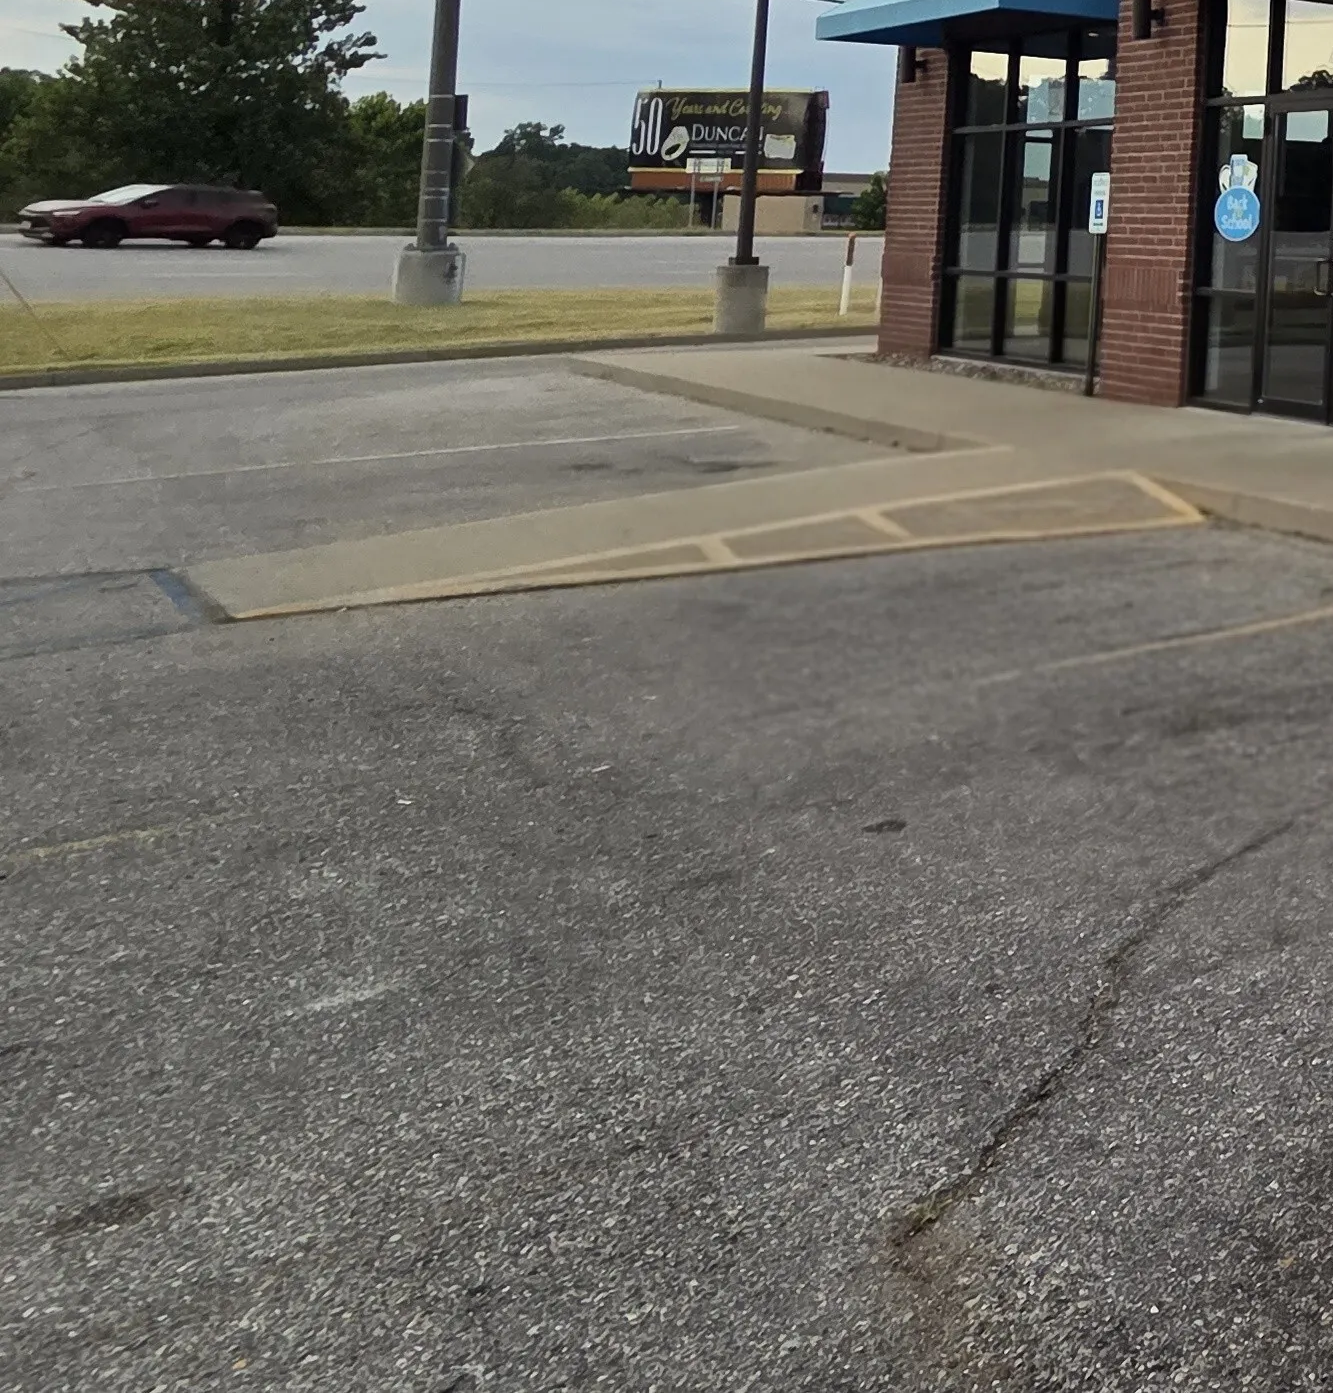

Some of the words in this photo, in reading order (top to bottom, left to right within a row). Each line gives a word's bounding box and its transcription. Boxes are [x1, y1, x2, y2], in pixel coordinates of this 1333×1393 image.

[666, 97, 703, 121] Years
[704, 100, 730, 114] and
[632, 97, 663, 155] 50
[1220, 213, 1253, 230] School
